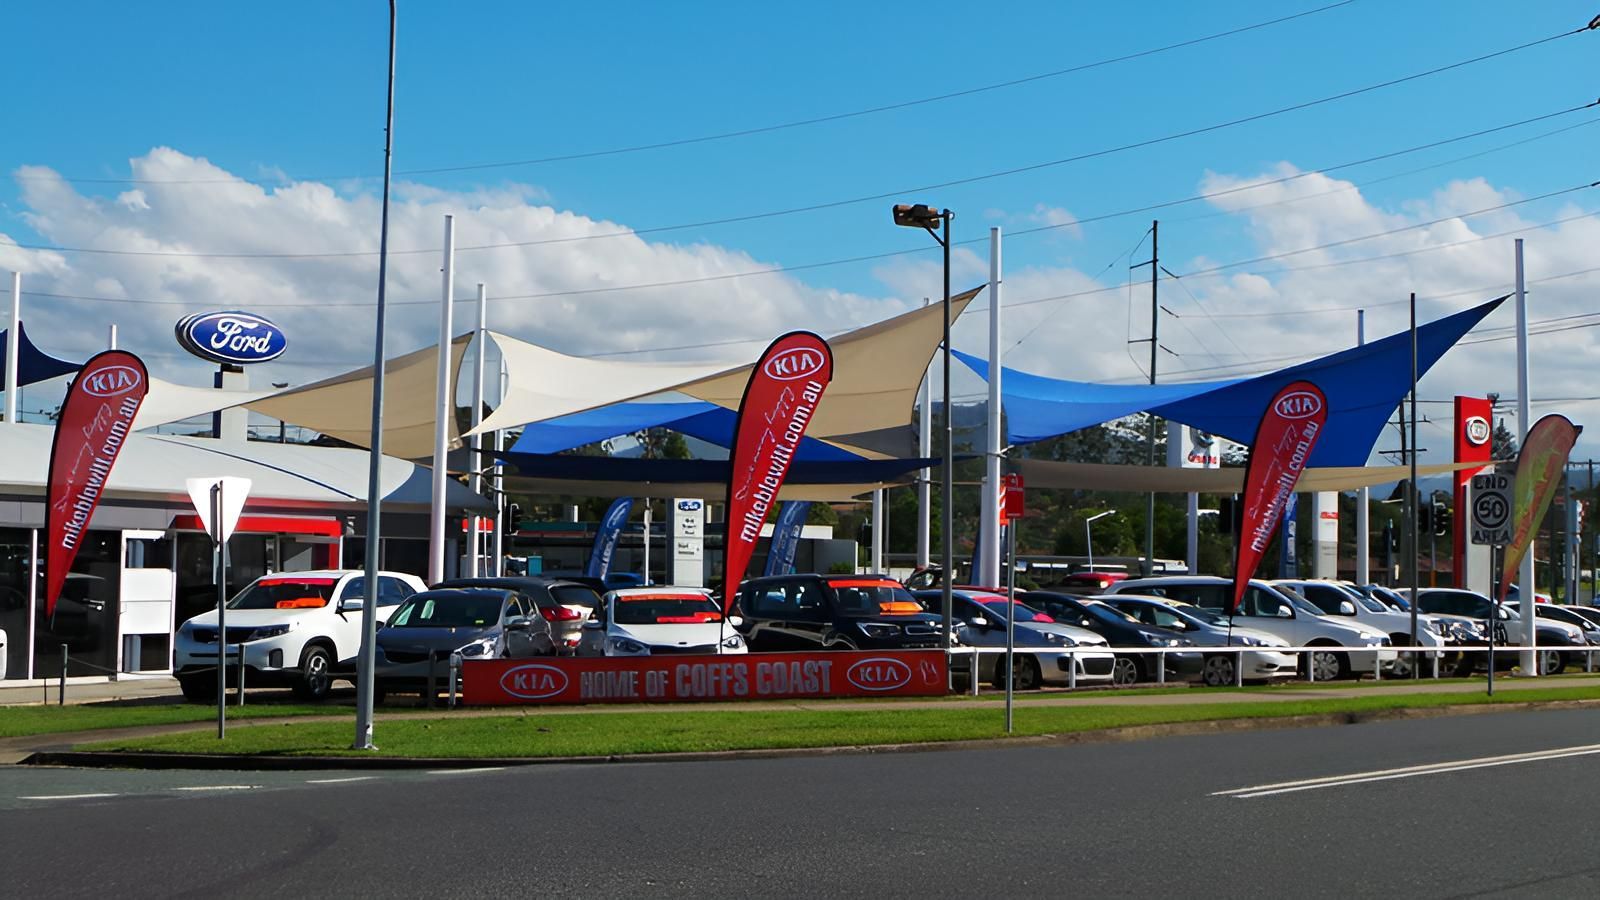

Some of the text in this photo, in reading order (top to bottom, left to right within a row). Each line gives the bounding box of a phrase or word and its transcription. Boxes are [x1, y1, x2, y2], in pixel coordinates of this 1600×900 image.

[211, 318, 272, 353] Ford
[774, 353, 815, 376] KIA
[91, 370, 131, 392] KIA
[1282, 397, 1313, 415] KIA
[1478, 500, 1504, 519] 50
[514, 673, 555, 690] KIA
[580, 660, 832, 697] HOME OF COFFS COAST
[860, 666, 899, 682] KIA
